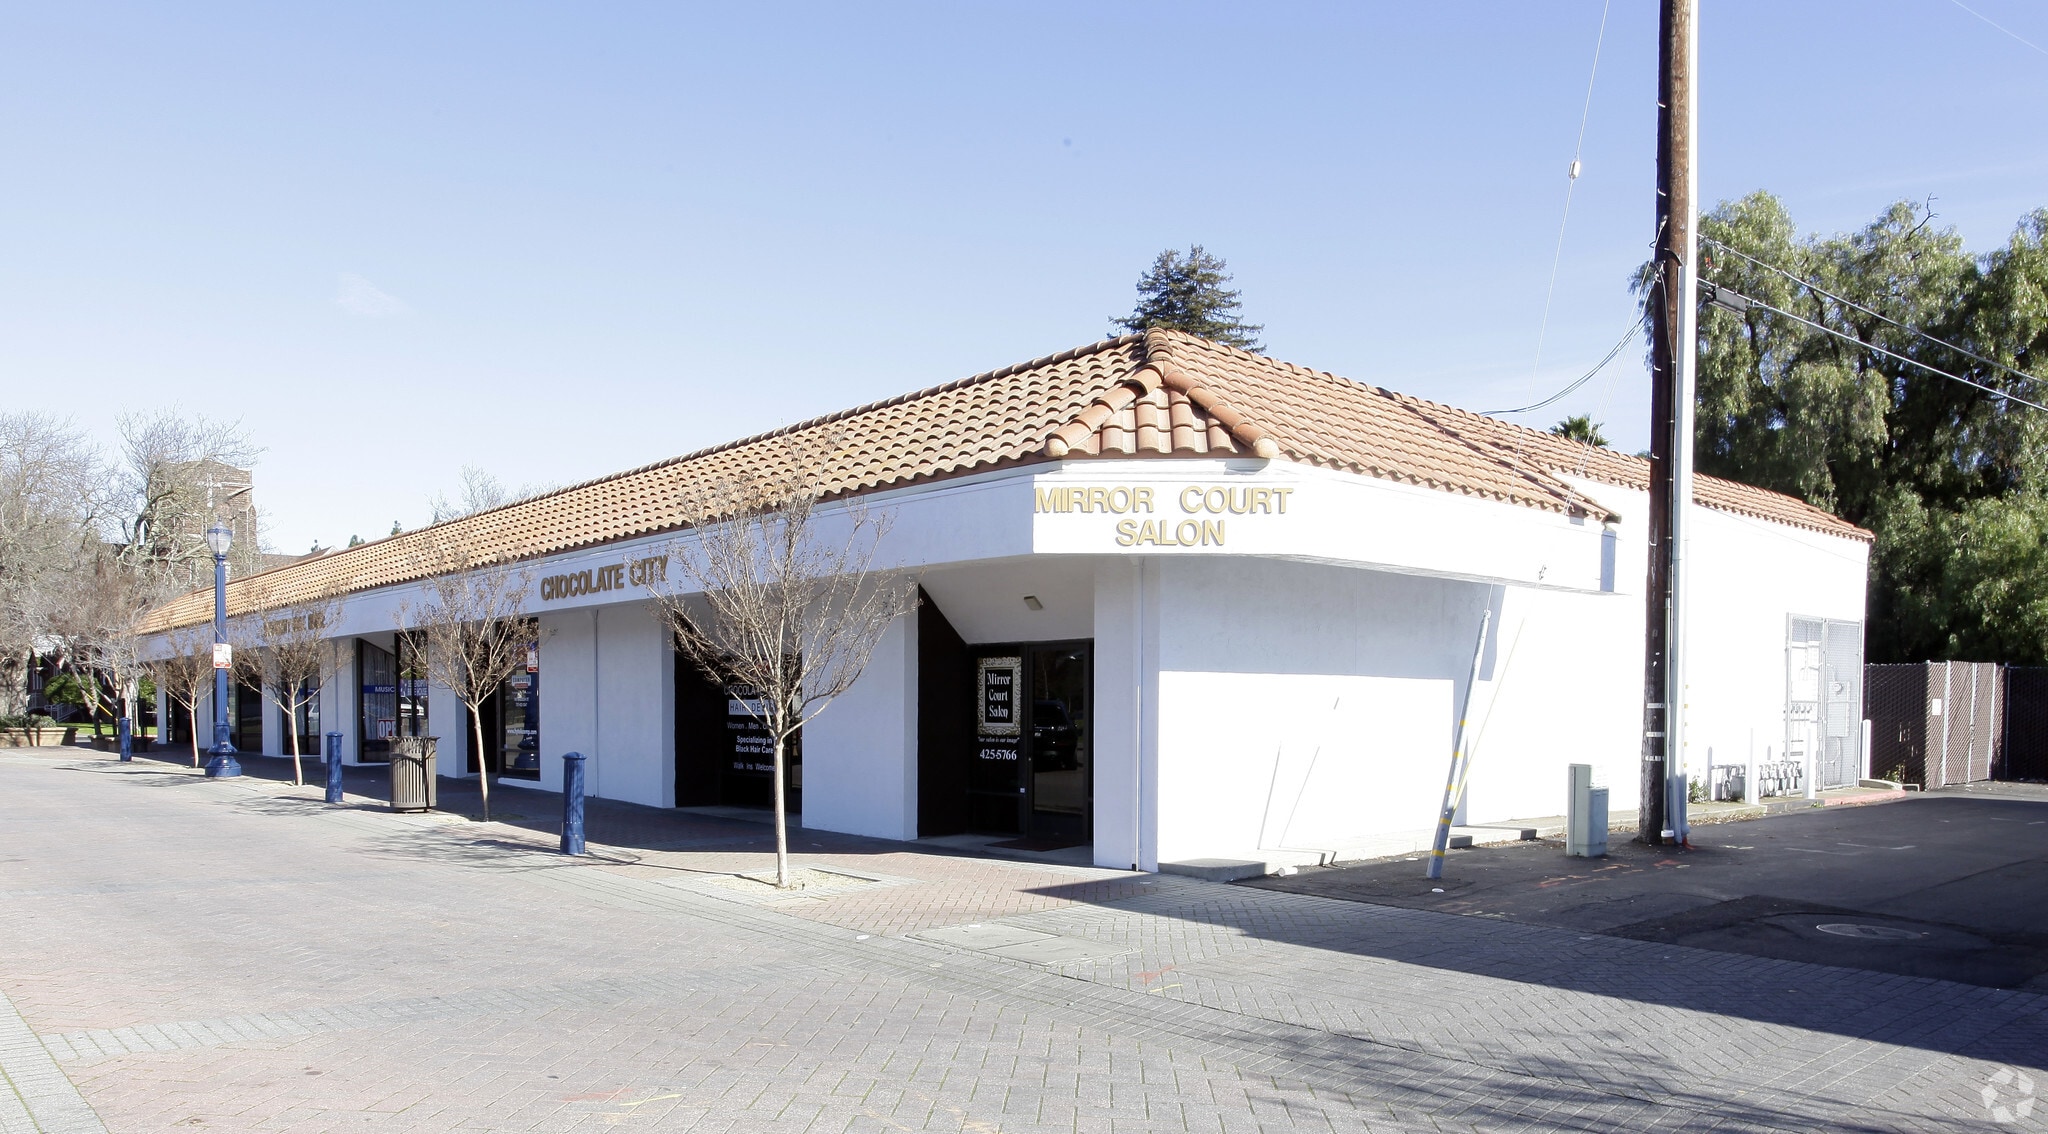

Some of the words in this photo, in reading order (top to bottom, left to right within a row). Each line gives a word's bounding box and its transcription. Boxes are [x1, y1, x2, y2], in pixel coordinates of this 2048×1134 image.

[1034, 486, 1155, 513] MIRROR
[1179, 486, 1294, 514] COURT
[1115, 518, 1226, 547] SALON
[541, 563, 625, 600] CHOCOLATE
[629, 554, 669, 586] CITY
[987, 673, 1011, 685] Mirror
[988, 689, 1008, 701] Court
[989, 705, 1009, 718] Salon
[737, 736, 767, 746] Specializing
[761, 746, 774, 754] Care
[980, 749, 1017, 760] 425-5766
